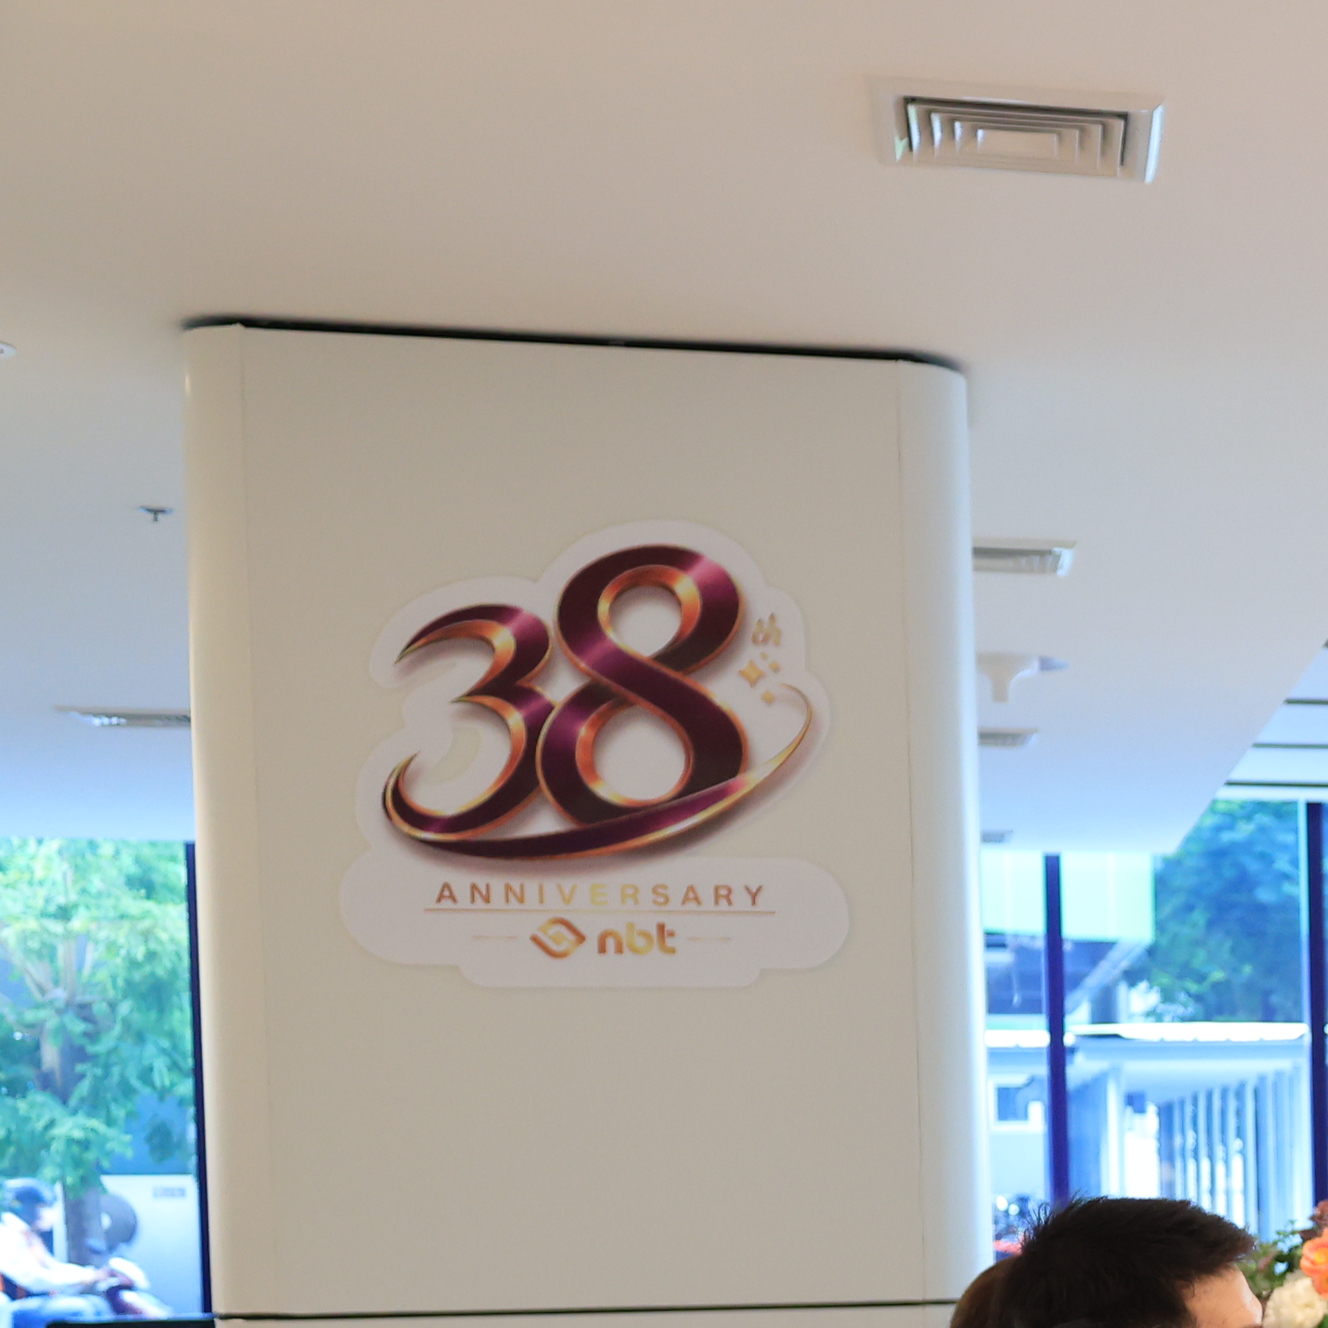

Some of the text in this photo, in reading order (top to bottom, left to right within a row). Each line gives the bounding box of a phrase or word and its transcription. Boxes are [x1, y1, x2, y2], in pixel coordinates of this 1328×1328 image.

[382, 543, 752, 860] 38
[435, 881, 765, 907] ANNIVERSARY
[598, 922, 677, 955] nbt
